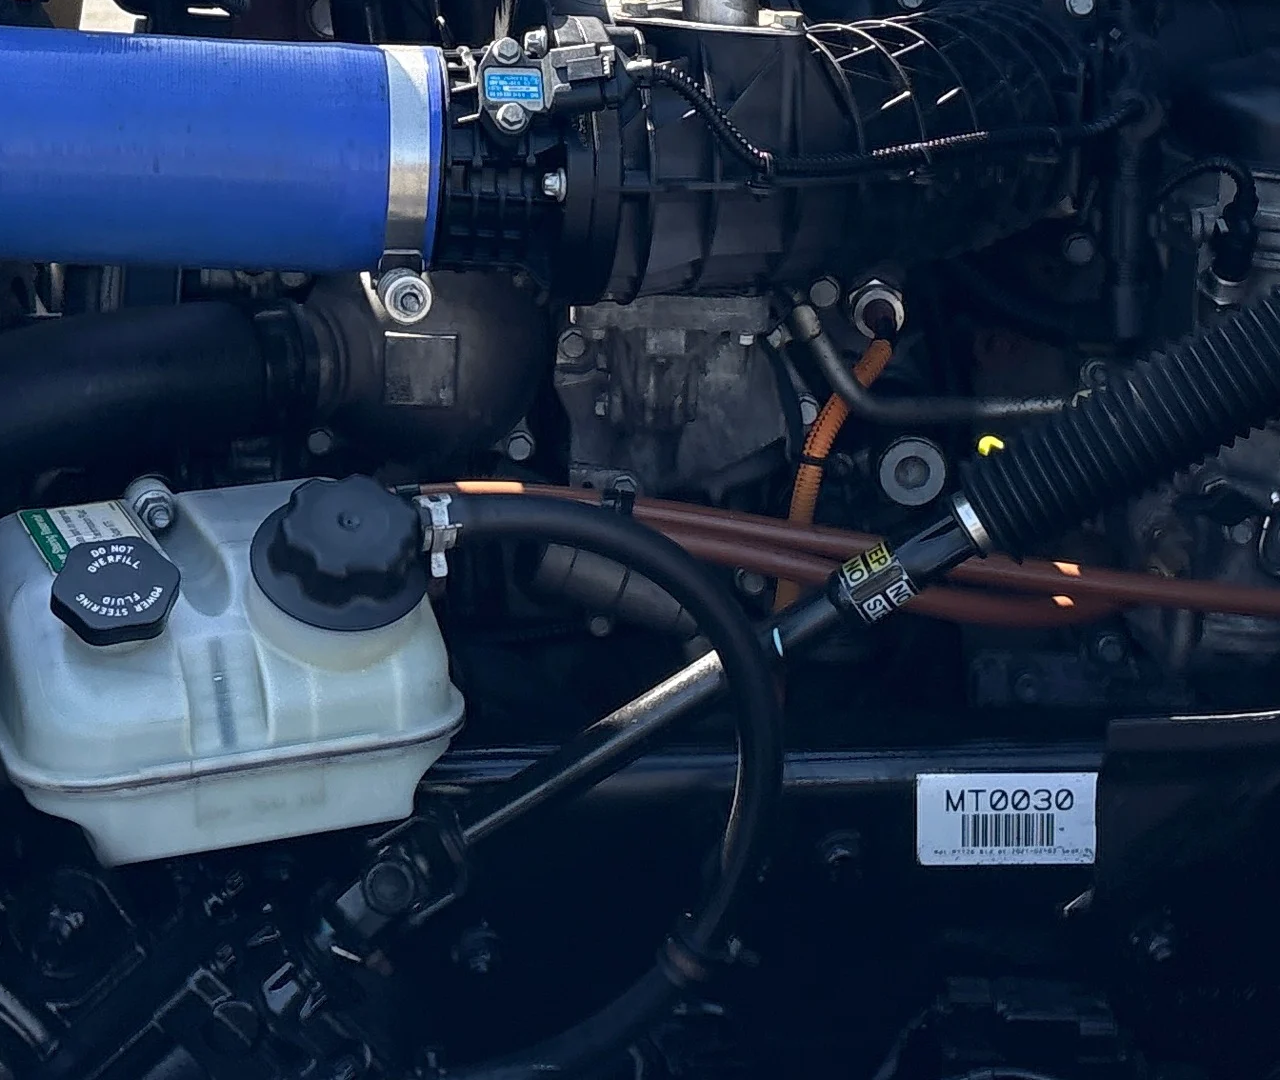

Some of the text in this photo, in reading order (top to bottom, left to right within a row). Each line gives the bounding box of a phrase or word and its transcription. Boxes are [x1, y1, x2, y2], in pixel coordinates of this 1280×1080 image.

[90, 544, 134, 558] DO NOT
[87, 554, 141, 573] OVERFILL
[75, 586, 164, 617] POWER STEERING
[102, 592, 141, 605] FLUID
[945, 788, 1074, 812] MT0030
